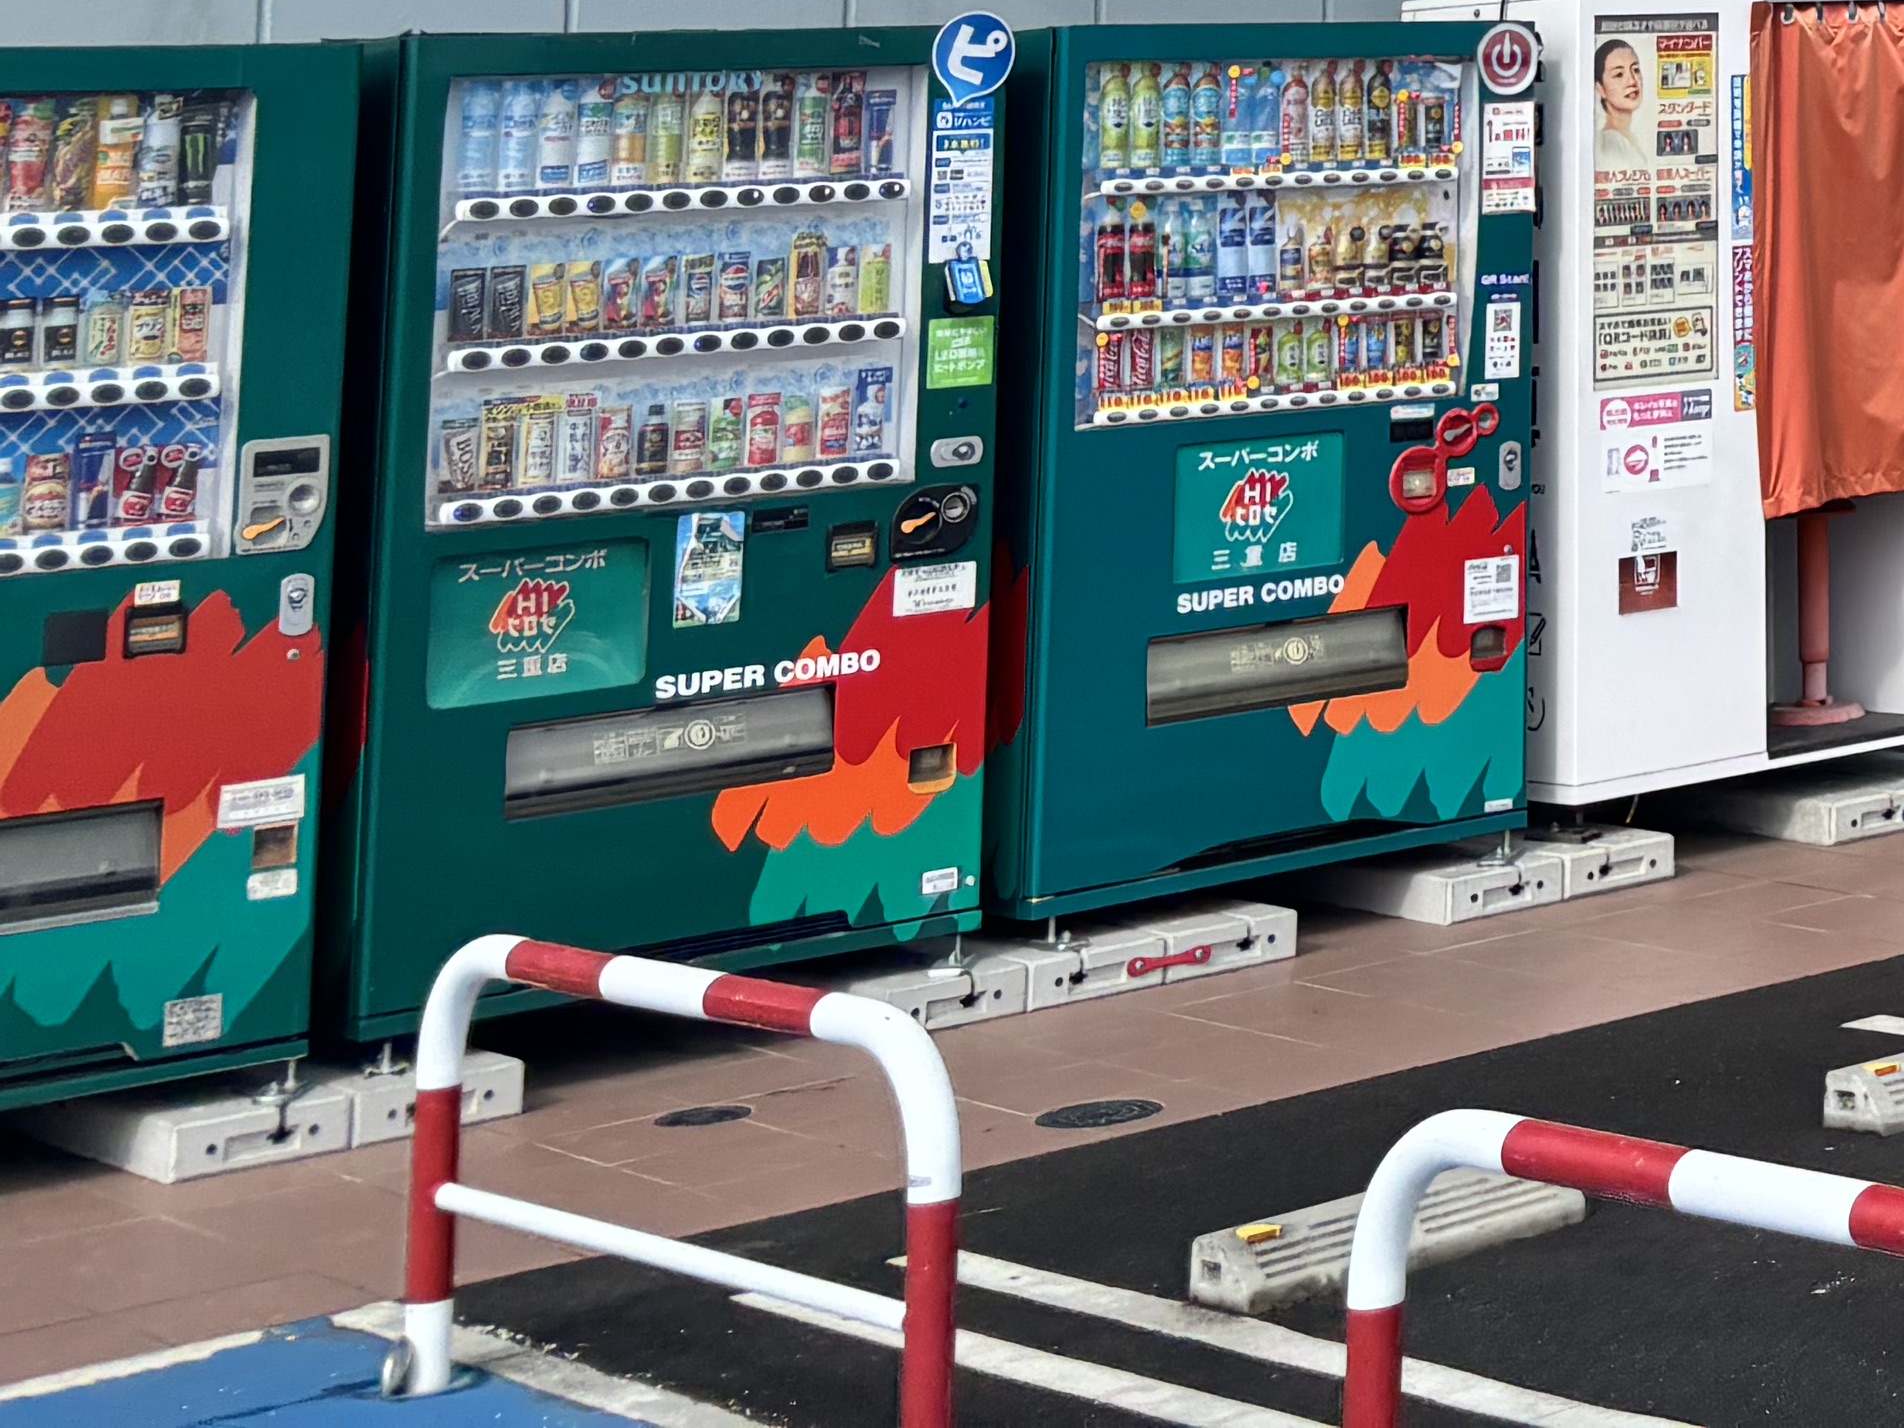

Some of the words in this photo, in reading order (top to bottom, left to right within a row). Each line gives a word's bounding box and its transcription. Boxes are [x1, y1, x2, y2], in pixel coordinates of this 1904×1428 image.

[1197, 440, 1320, 471] スーパーコンボ
[1243, 481, 1274, 503] HI
[458, 548, 608, 583] スーパーコンボ
[516, 591, 549, 616] HI
[1176, 584, 1255, 615] SUPER
[1260, 574, 1345, 604] COMBO
[496, 653, 569, 681] 三重店
[655, 663, 766, 700] SUPER
[773, 648, 881, 684] COMBO
